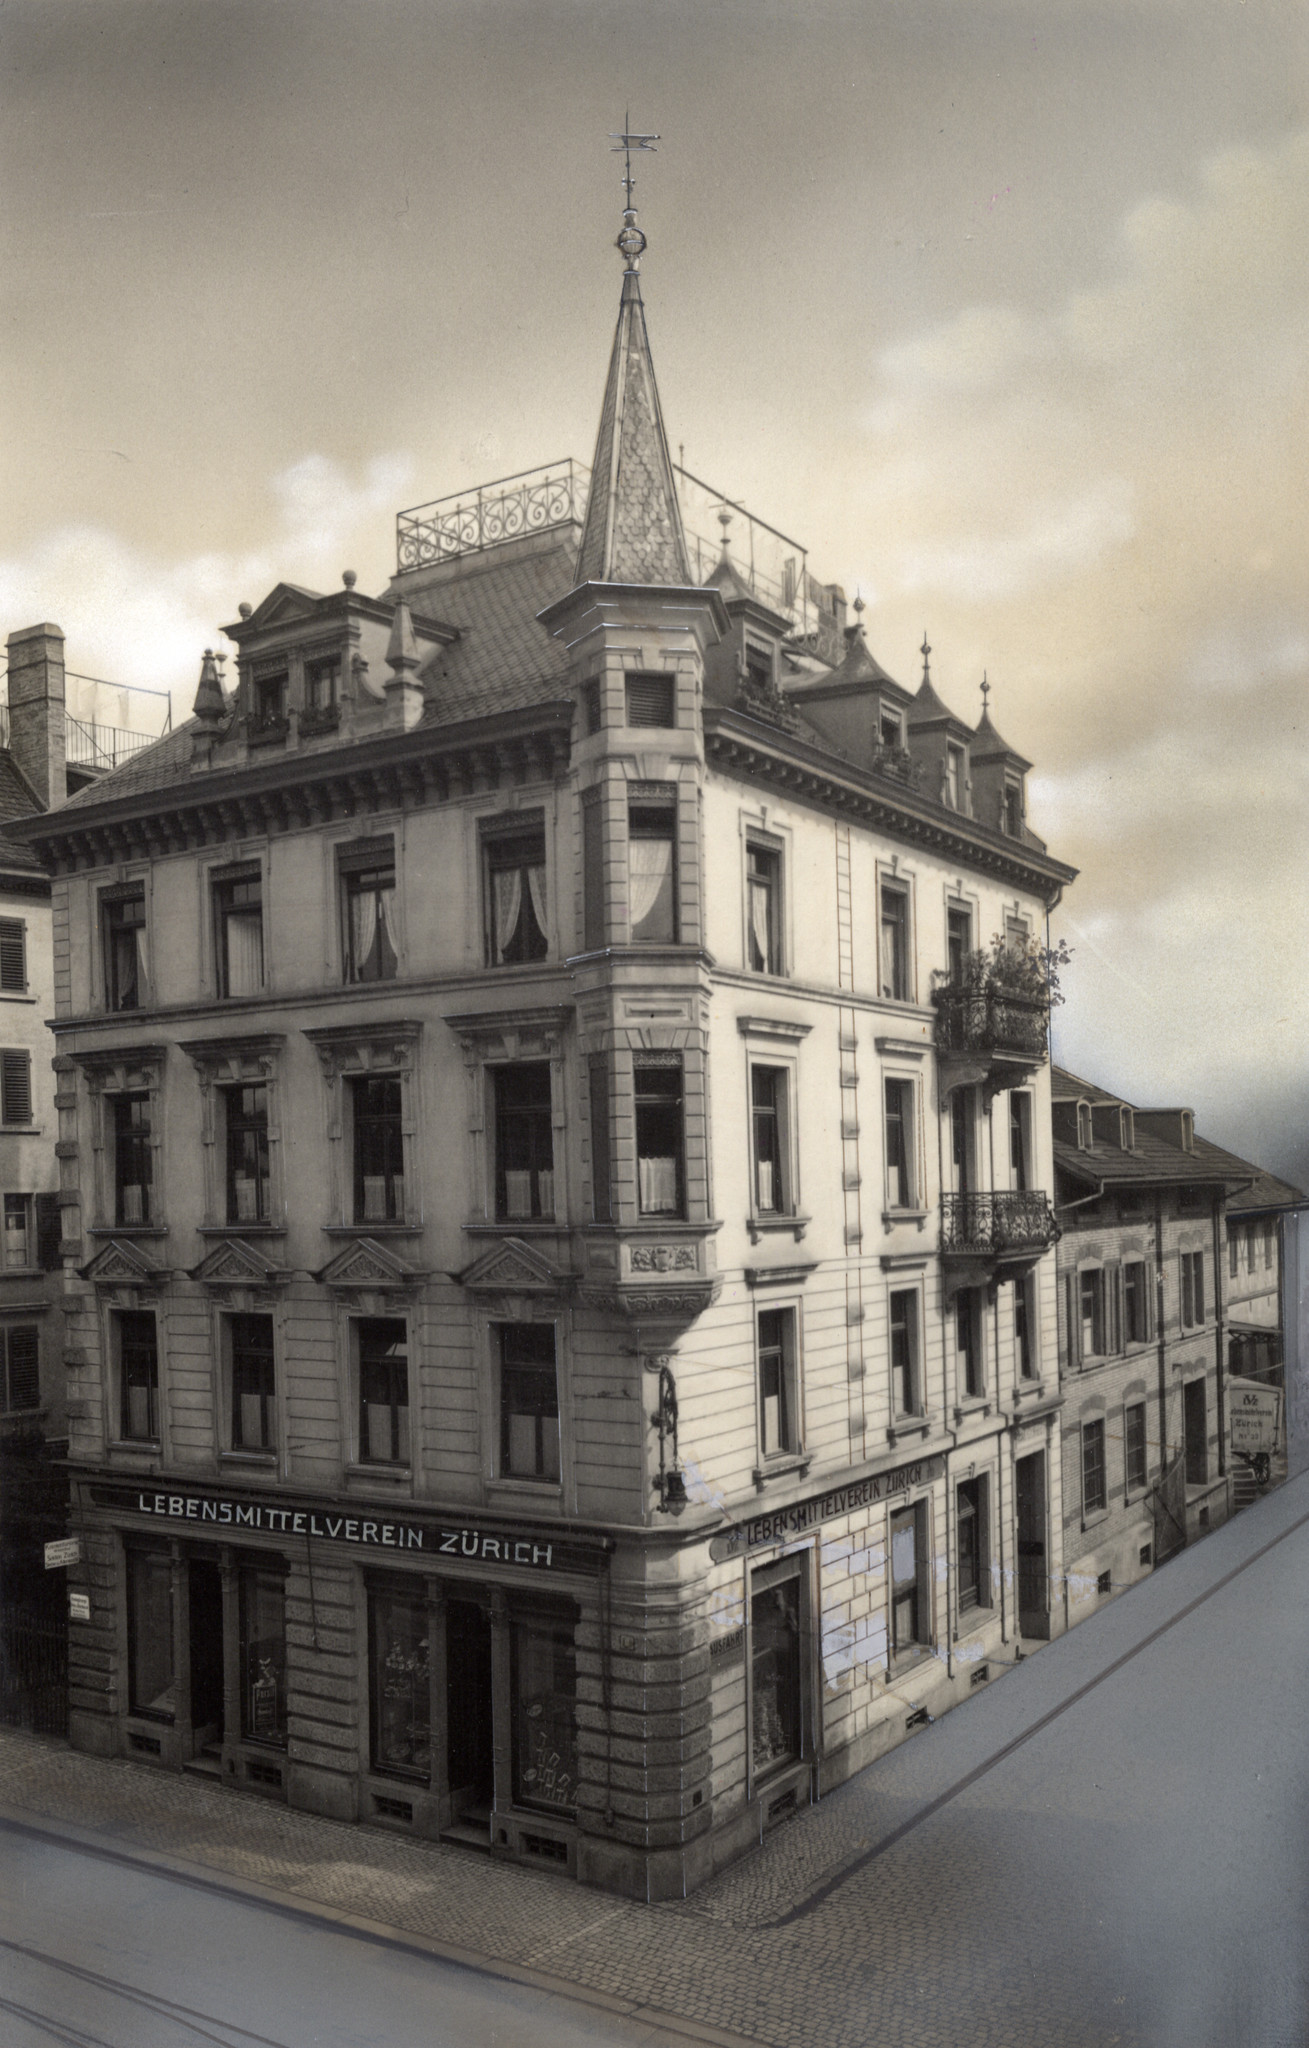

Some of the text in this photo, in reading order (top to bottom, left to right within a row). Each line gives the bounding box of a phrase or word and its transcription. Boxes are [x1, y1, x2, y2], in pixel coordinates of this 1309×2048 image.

[138, 1494, 552, 1566] LEBENSMITTELVEREIN ZÜRICH
[748, 1476, 880, 1545] LEBENSMITTELVEREIN
